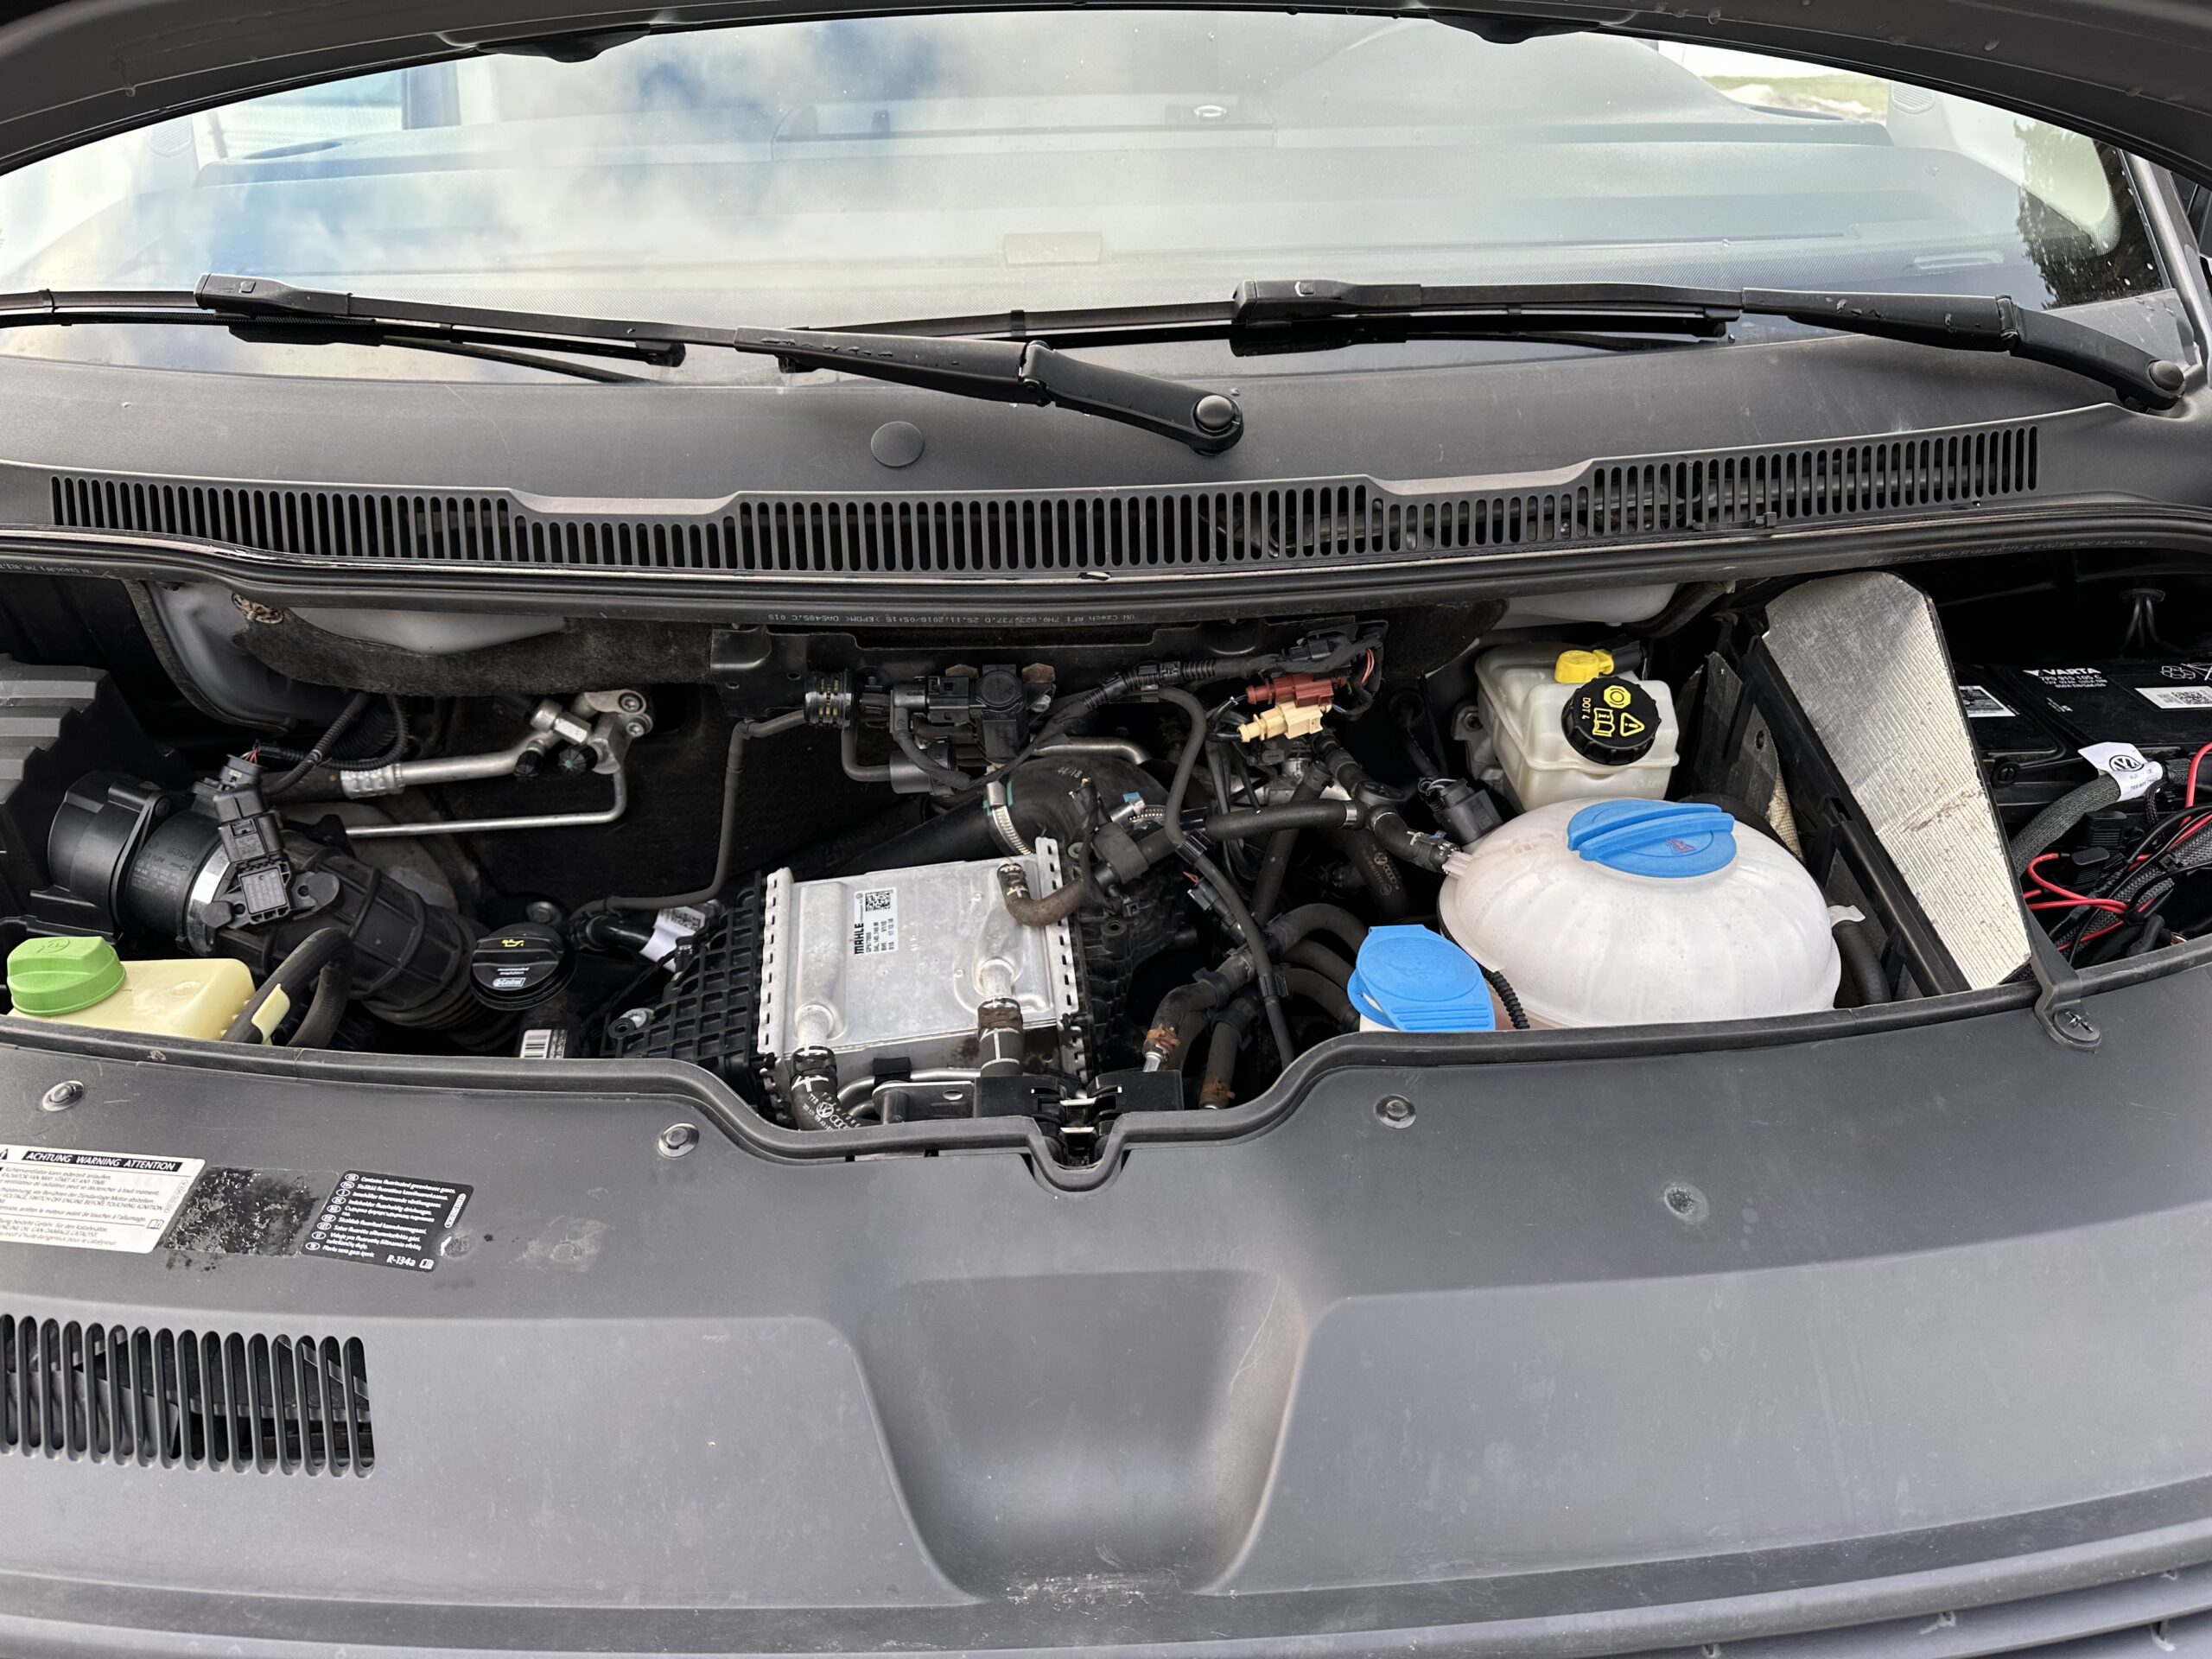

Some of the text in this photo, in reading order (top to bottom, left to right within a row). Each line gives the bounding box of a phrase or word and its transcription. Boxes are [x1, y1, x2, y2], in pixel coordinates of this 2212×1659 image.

[1582, 697, 1592, 714] DOT
[167, 848, 198, 862] BOSCH
[854, 923, 864, 955] MAHLE
[27, 1153, 176, 1172] ACHTUNG WARNING ATTENTION
[383, 1179, 411, 1188] fluorinated
[386, 1254, 416, 1267] R-134a
